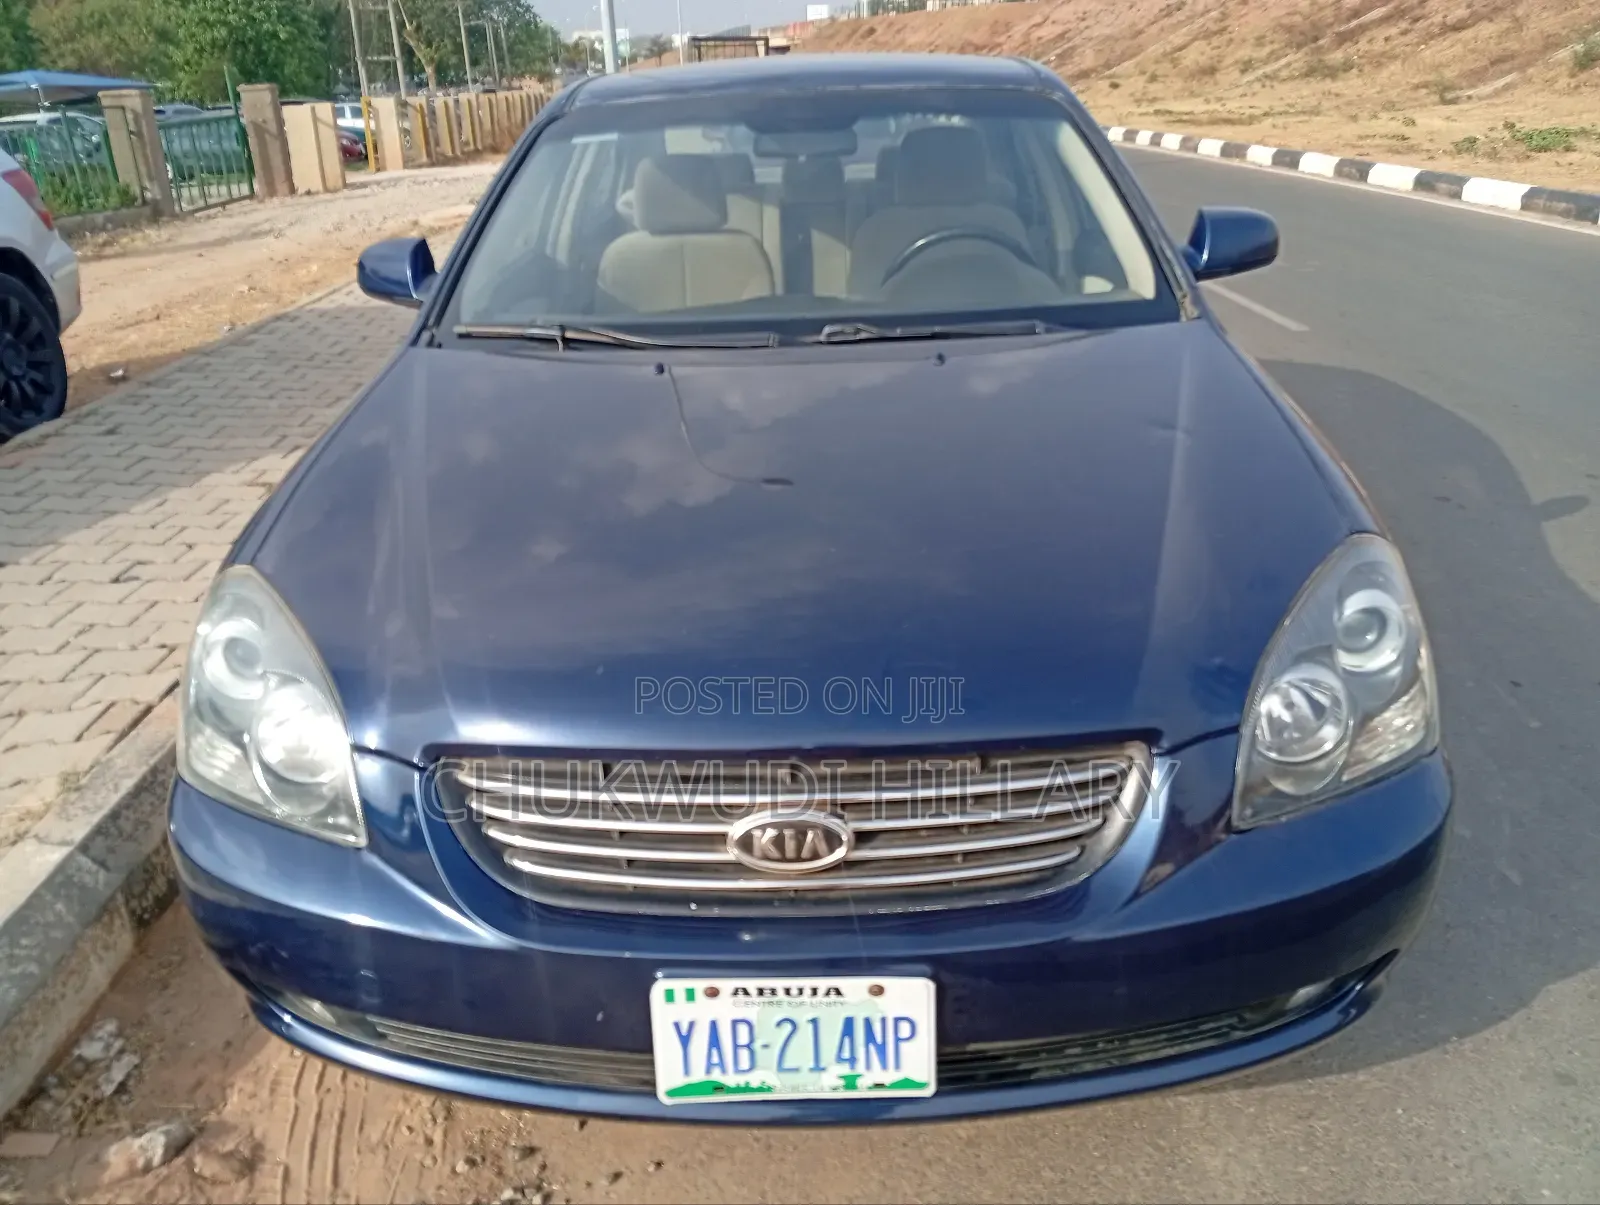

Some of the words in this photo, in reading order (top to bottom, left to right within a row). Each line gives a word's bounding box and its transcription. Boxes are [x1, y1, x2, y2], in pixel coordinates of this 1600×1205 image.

[751, 827, 828, 860] KIA
[731, 986, 844, 998] ABUJA
[673, 1016, 917, 1077] YAB-214NP
